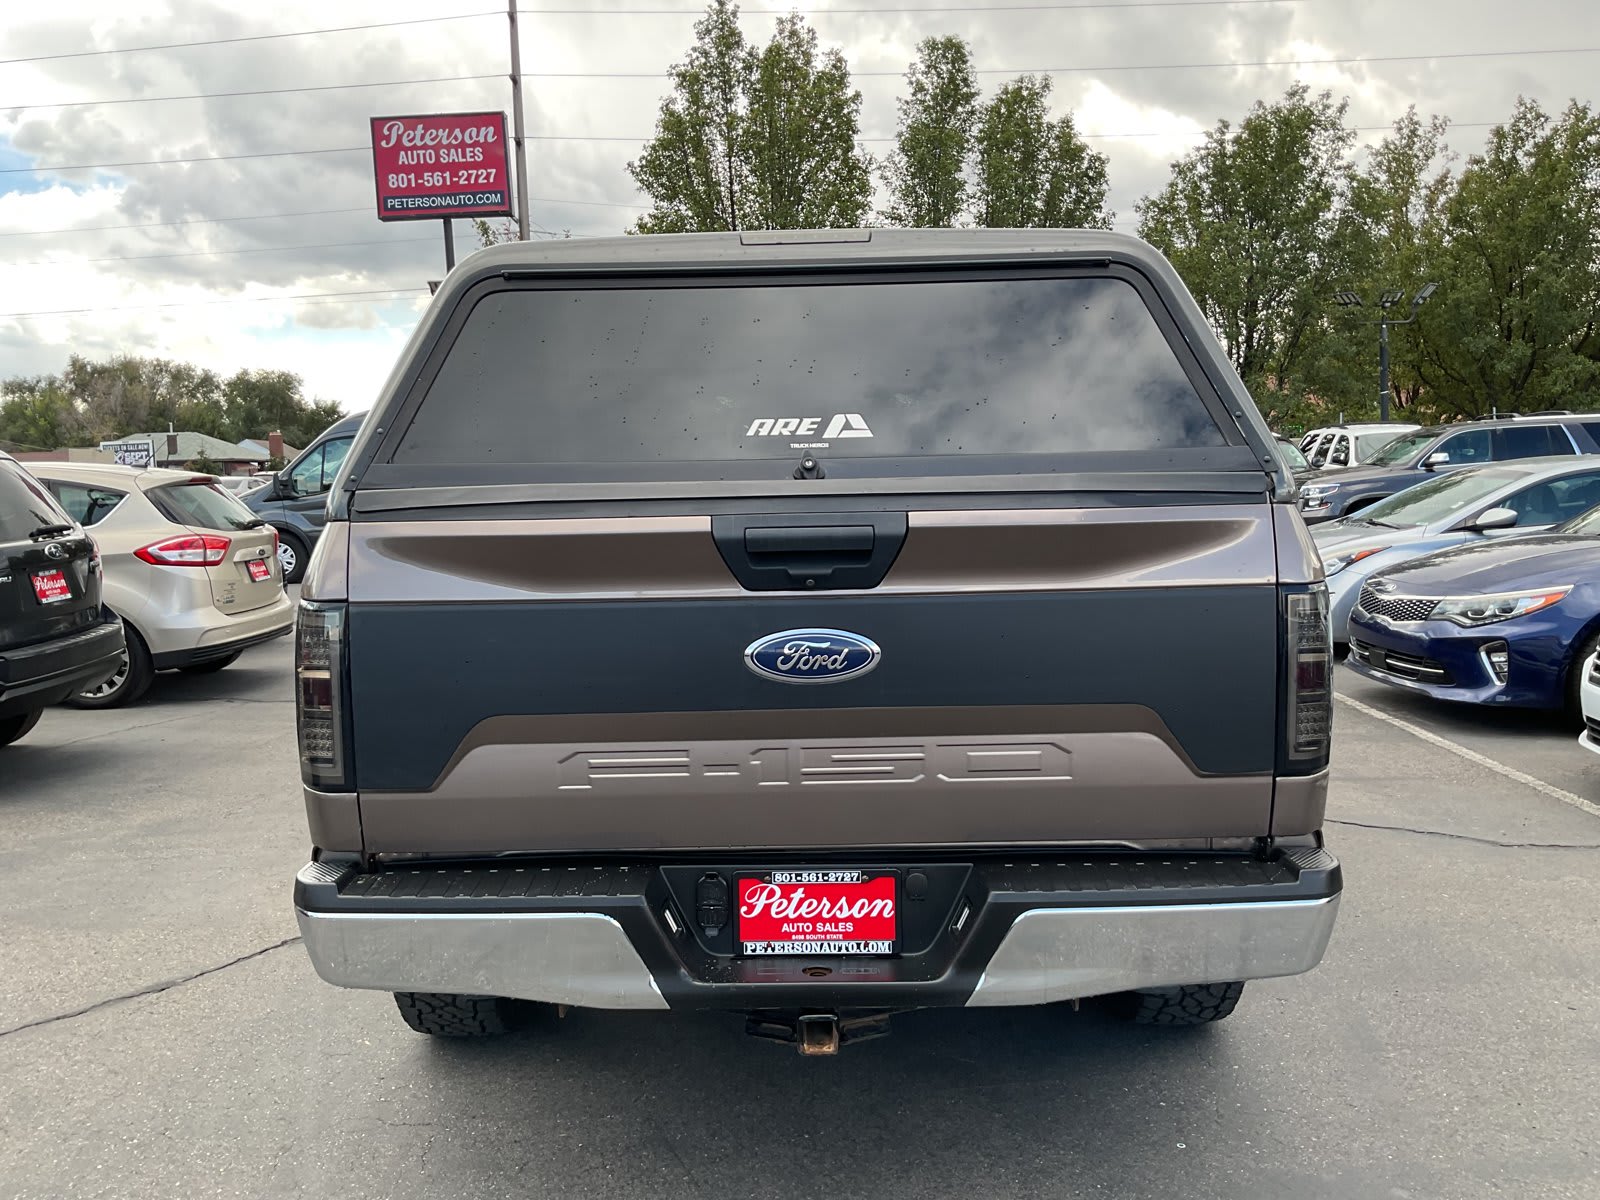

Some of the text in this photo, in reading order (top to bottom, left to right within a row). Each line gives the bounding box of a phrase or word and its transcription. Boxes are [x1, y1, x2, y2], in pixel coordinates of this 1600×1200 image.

[381, 121, 497, 148] Peterson
[399, 147, 484, 165] AUTO SALES
[388, 169, 497, 188] 801-561-2727
[387, 193, 501, 209] PETERSONAUTO.COM
[745, 417, 822, 436] ARE
[776, 640, 849, 671] Ford
[557, 742, 1073, 790] F-150
[774, 872, 859, 883] 801-561-2727
[740, 884, 895, 919] Peterson
[781, 922, 854, 933] AUTO SALES
[746, 941, 889, 954] PETERSONAUTO.COM
